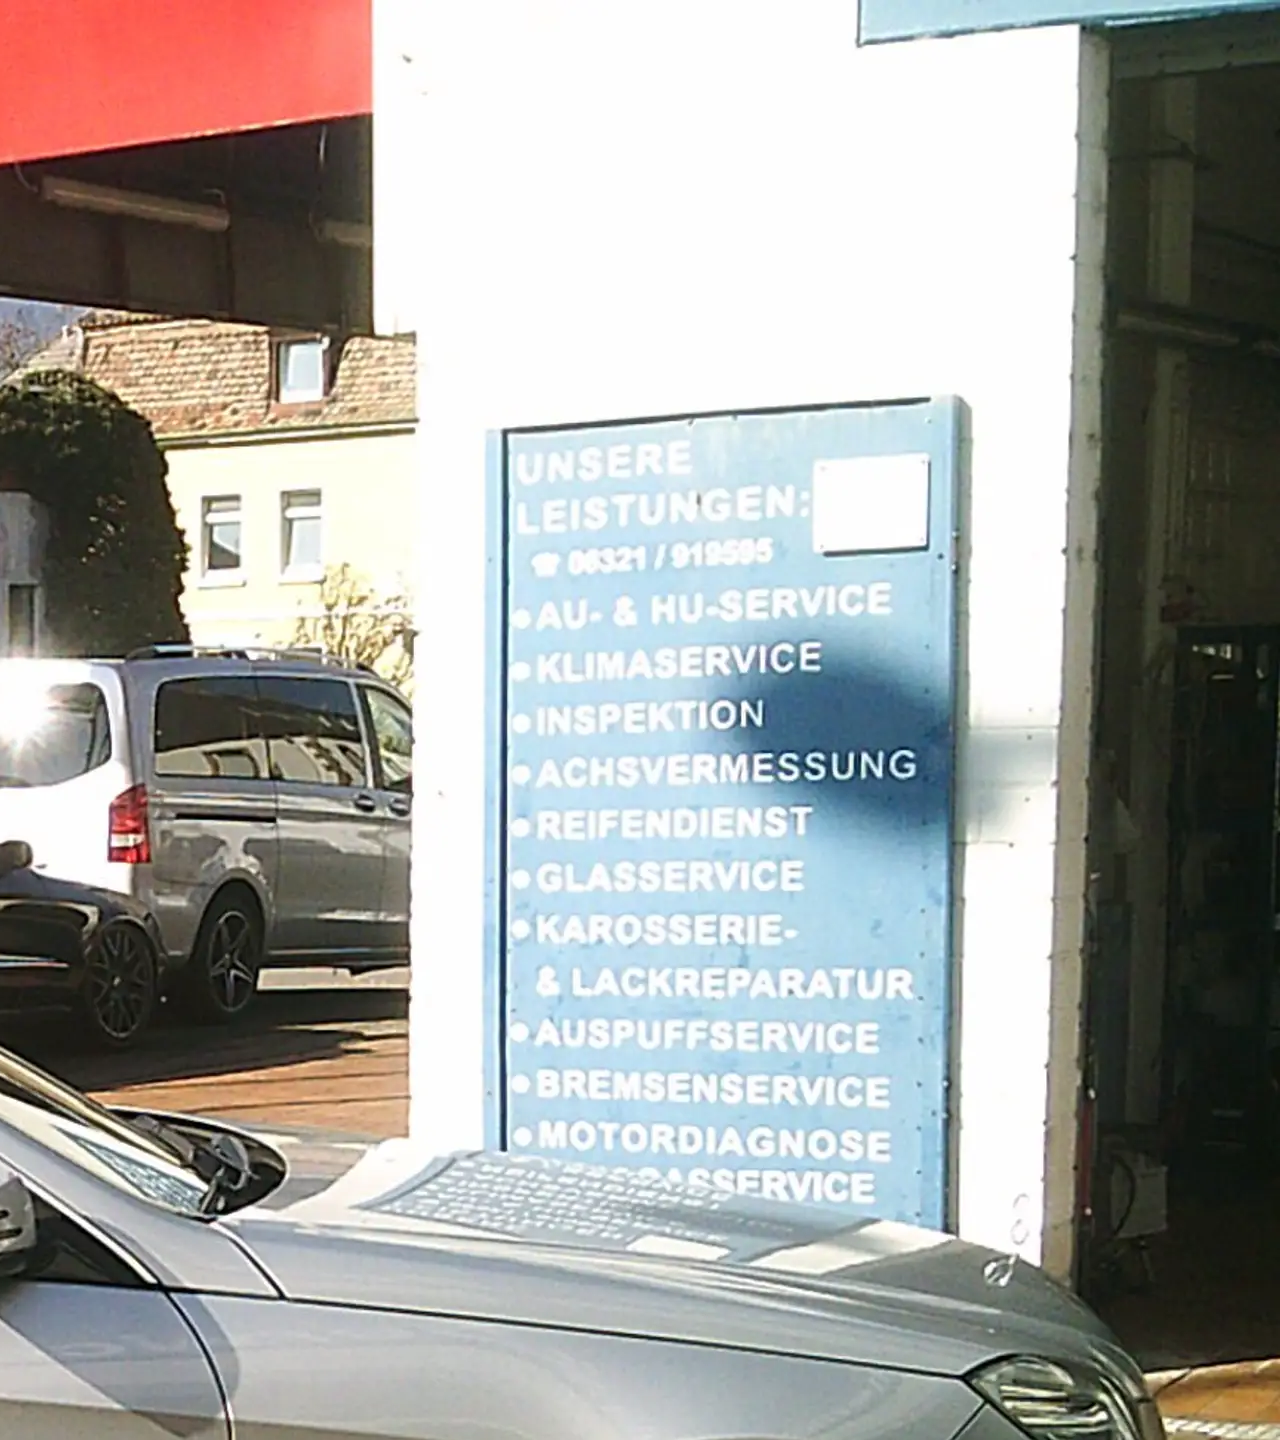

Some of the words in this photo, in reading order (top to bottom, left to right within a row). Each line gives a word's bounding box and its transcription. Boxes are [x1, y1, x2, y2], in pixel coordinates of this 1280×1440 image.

[516, 440, 694, 484] UNSERE
[516, 484, 811, 534] LEISTUNGEN:
[536, 600, 601, 631] AU-
[613, 595, 638, 626] &
[651, 582, 893, 624] HU-SERVICE
[537, 642, 823, 683] KLIMASERVICE
[537, 699, 765, 736] INSPEKTION
[536, 749, 918, 787] ACHSVERMESSUNG
[537, 806, 814, 841] REIFENDIENST
[536, 861, 805, 893] GLASSERVICE
[536, 914, 799, 947] KAROSSERIE-
[536, 965, 561, 997] &
[572, 967, 915, 1000] LACKREPARATUR
[535, 1018, 880, 1054] AUSPUFFSERVICE
[536, 1069, 891, 1108] BREMSENSERVICE
[539, 1120, 892, 1163] MOTORDIAGNOSE
